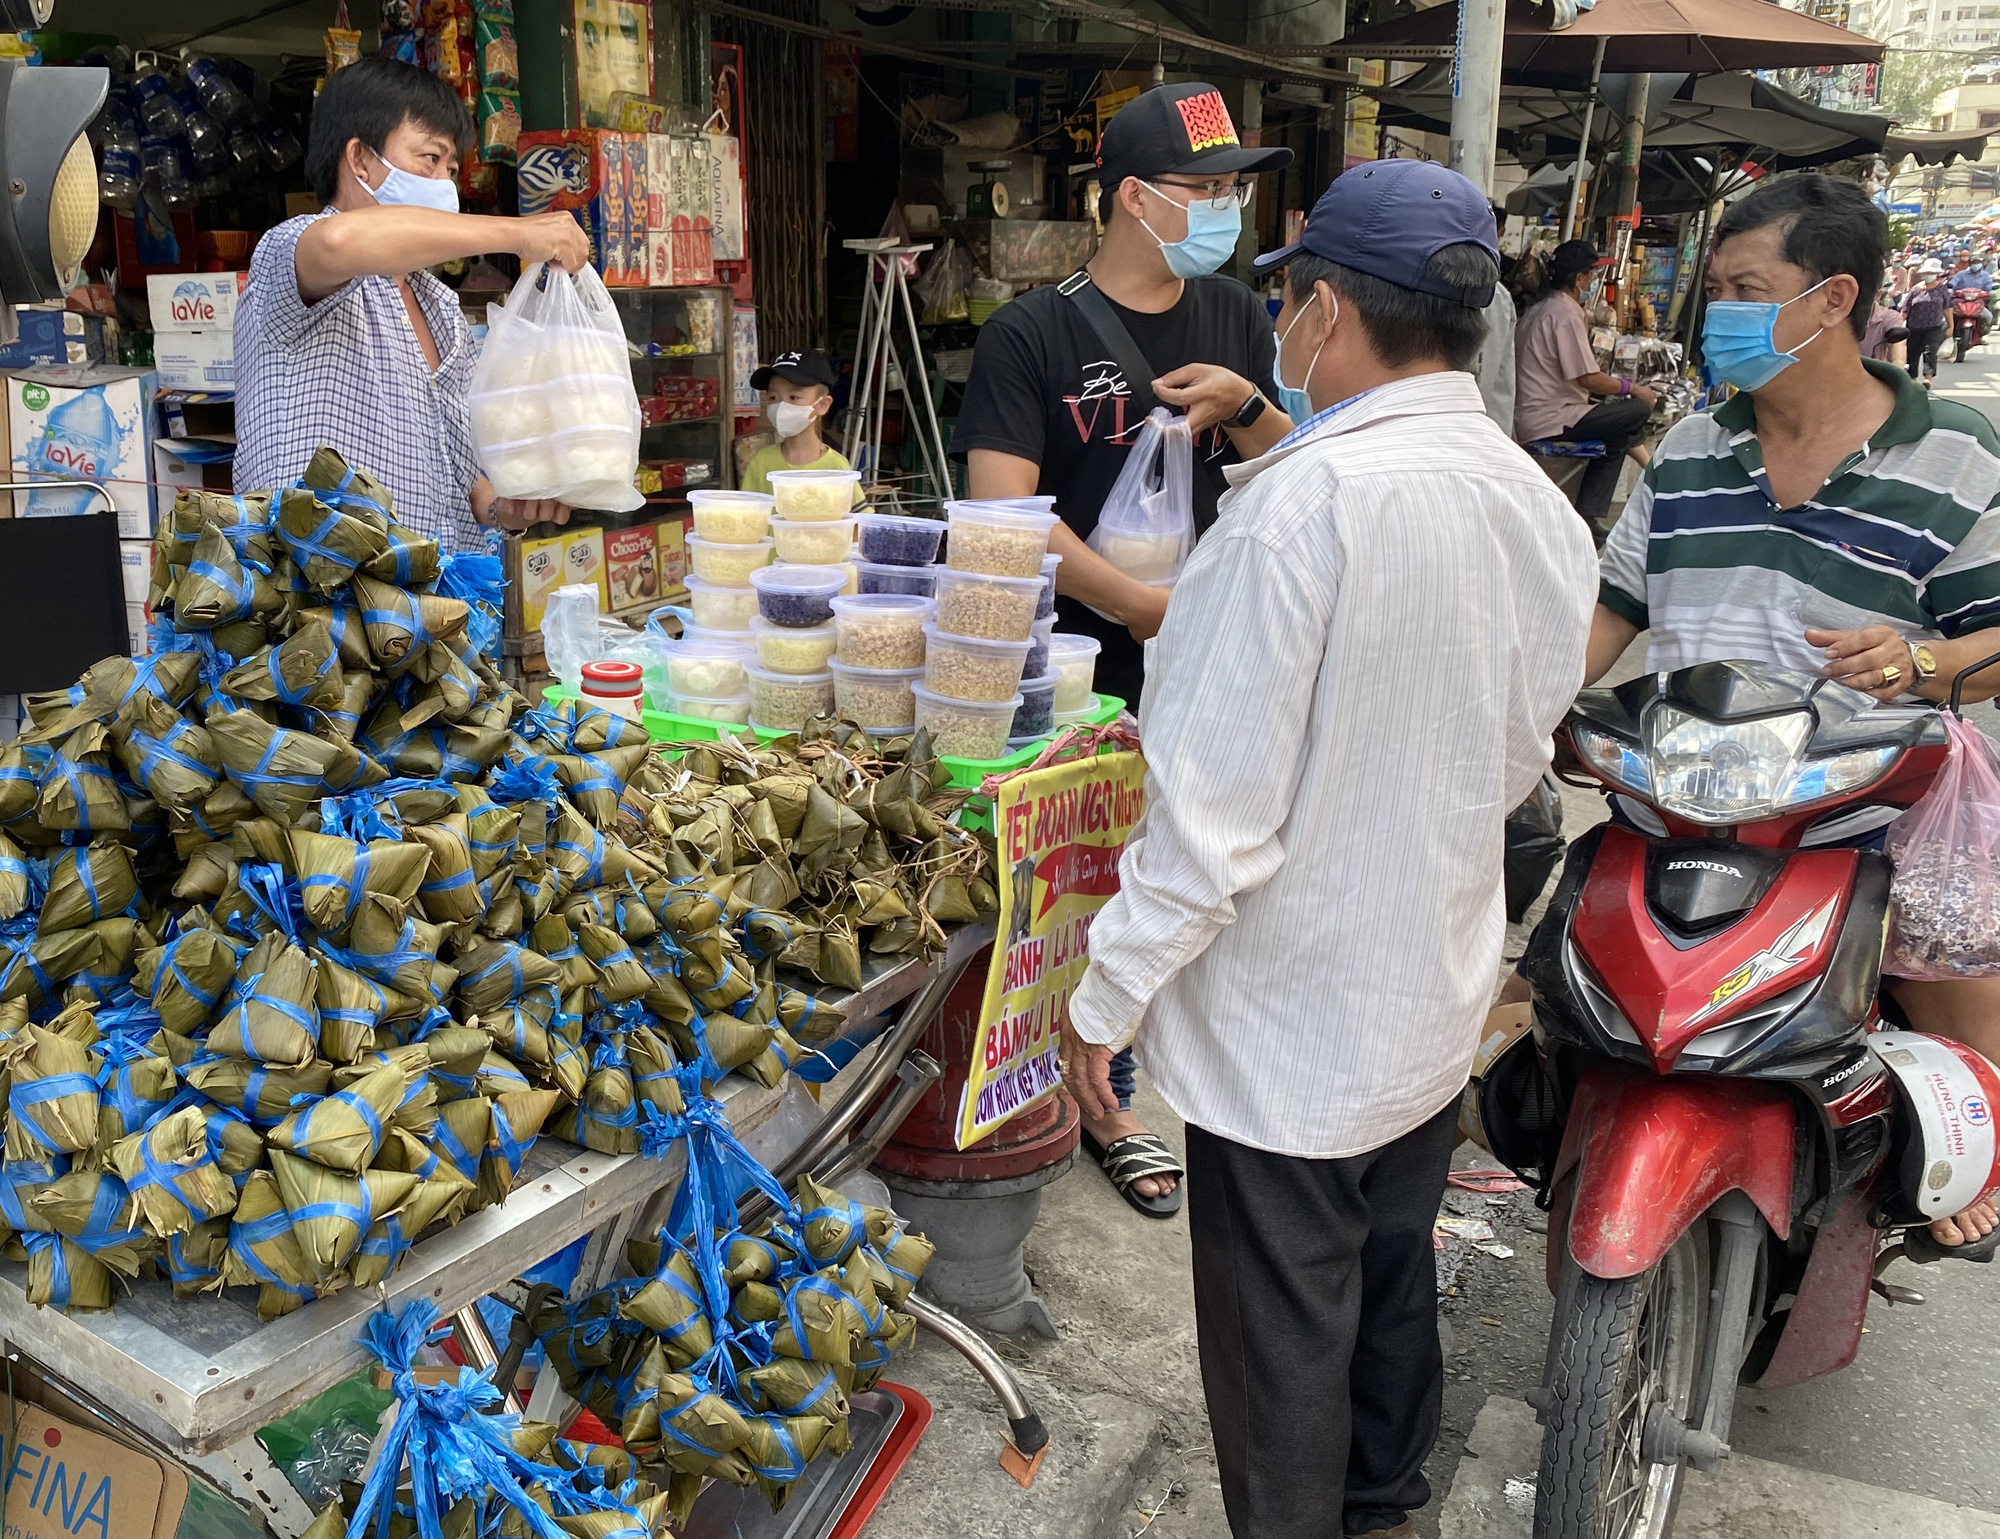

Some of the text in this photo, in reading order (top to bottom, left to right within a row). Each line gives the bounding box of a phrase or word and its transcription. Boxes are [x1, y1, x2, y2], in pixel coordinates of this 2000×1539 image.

[605, 166, 625, 242] Tiger
[628, 169, 648, 244] Tiger
[711, 155, 725, 236] AQUAFINA
[171, 297, 215, 321] laVie
[45, 442, 96, 476] laVie
[1666, 861, 1743, 878] HONDA
[986, 1007, 1034, 1071] BÁNH
[1822, 1055, 1870, 1088] HONDA
[18, 1425, 38, 1440] OF
[0, 1434, 112, 1539] FINA
